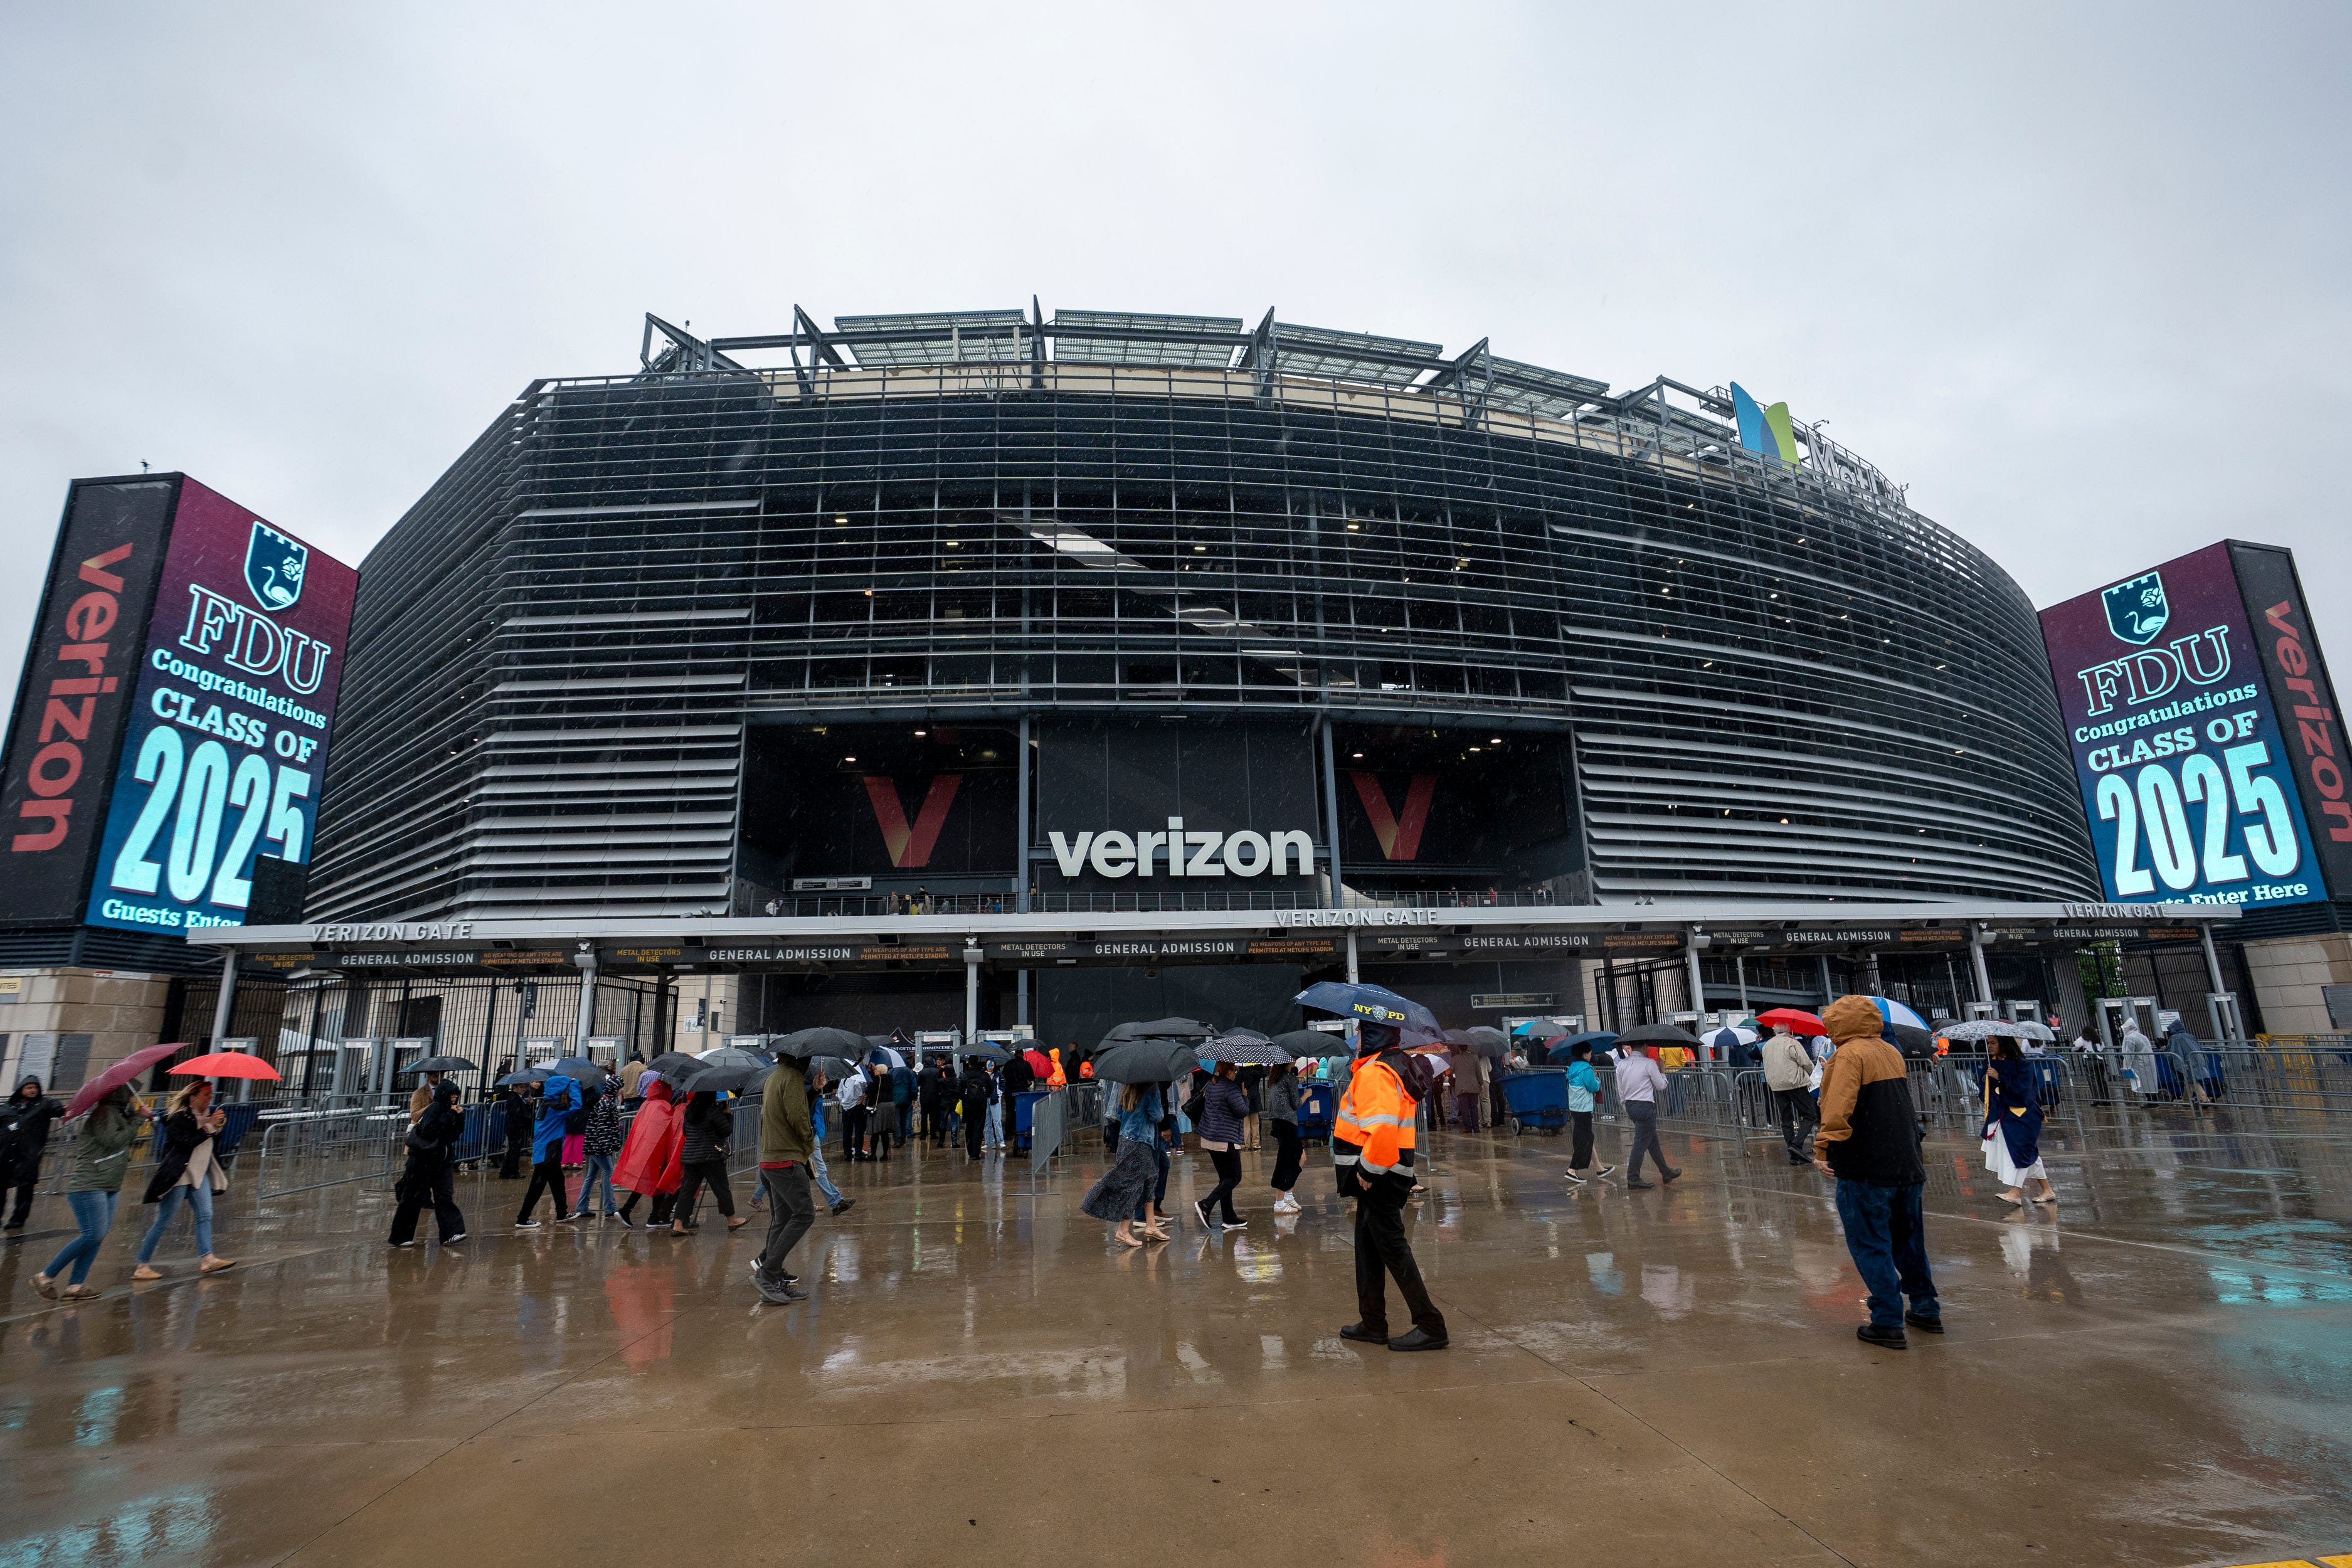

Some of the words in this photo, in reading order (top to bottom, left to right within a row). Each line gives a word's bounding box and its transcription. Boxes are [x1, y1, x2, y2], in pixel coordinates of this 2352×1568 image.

[179, 583, 331, 694] FDU
[2078, 625, 2230, 717] FDU
[11, 543, 134, 852] verizon
[151, 648, 327, 729] Congratulations
[151, 688, 268, 748] CLASS
[274, 730, 318, 763] OF
[2075, 684, 2258, 744] Congratulations
[2265, 600, 2352, 843] verizon
[2088, 728, 2197, 771] CLASS
[2207, 710, 2258, 744] OF
[110, 725, 312, 908] 2025
[2095, 741, 2301, 897] 2025
[1048, 816, 1315, 877] verizon
[2252, 883, 2308, 901] Here
[102, 899, 182, 927] Guests
[1276, 909, 1374, 928] VERIZON
[1383, 908, 1439, 926] GATE
[2064, 904, 2127, 918] VERIZON
[2132, 904, 2168, 918] GATE
[313, 924, 406, 941] VERIZON
[415, 923, 472, 940] GATE
[1465, 937, 1520, 947] GENERAL
[1524, 936, 1589, 946] ADMISSION
[1786, 933, 1833, 941] GENERAL
[1836, 931, 1891, 941] ADMISSION
[2053, 930, 2092, 938] GENERAL
[2094, 929, 2139, 937] ADMISSION
[341, 955, 399, 965] GENERAL
[405, 953, 474, 964] ADMISSION
[710, 949, 771, 960] GENERAL
[776, 948, 851, 960] ADMISSION
[1095, 944, 1156, 954] GENERAL
[1161, 942, 1234, 953] ADMISSION
[1353, 1004, 1372, 1015] NY
[1387, 1010, 1406, 1021] PD
